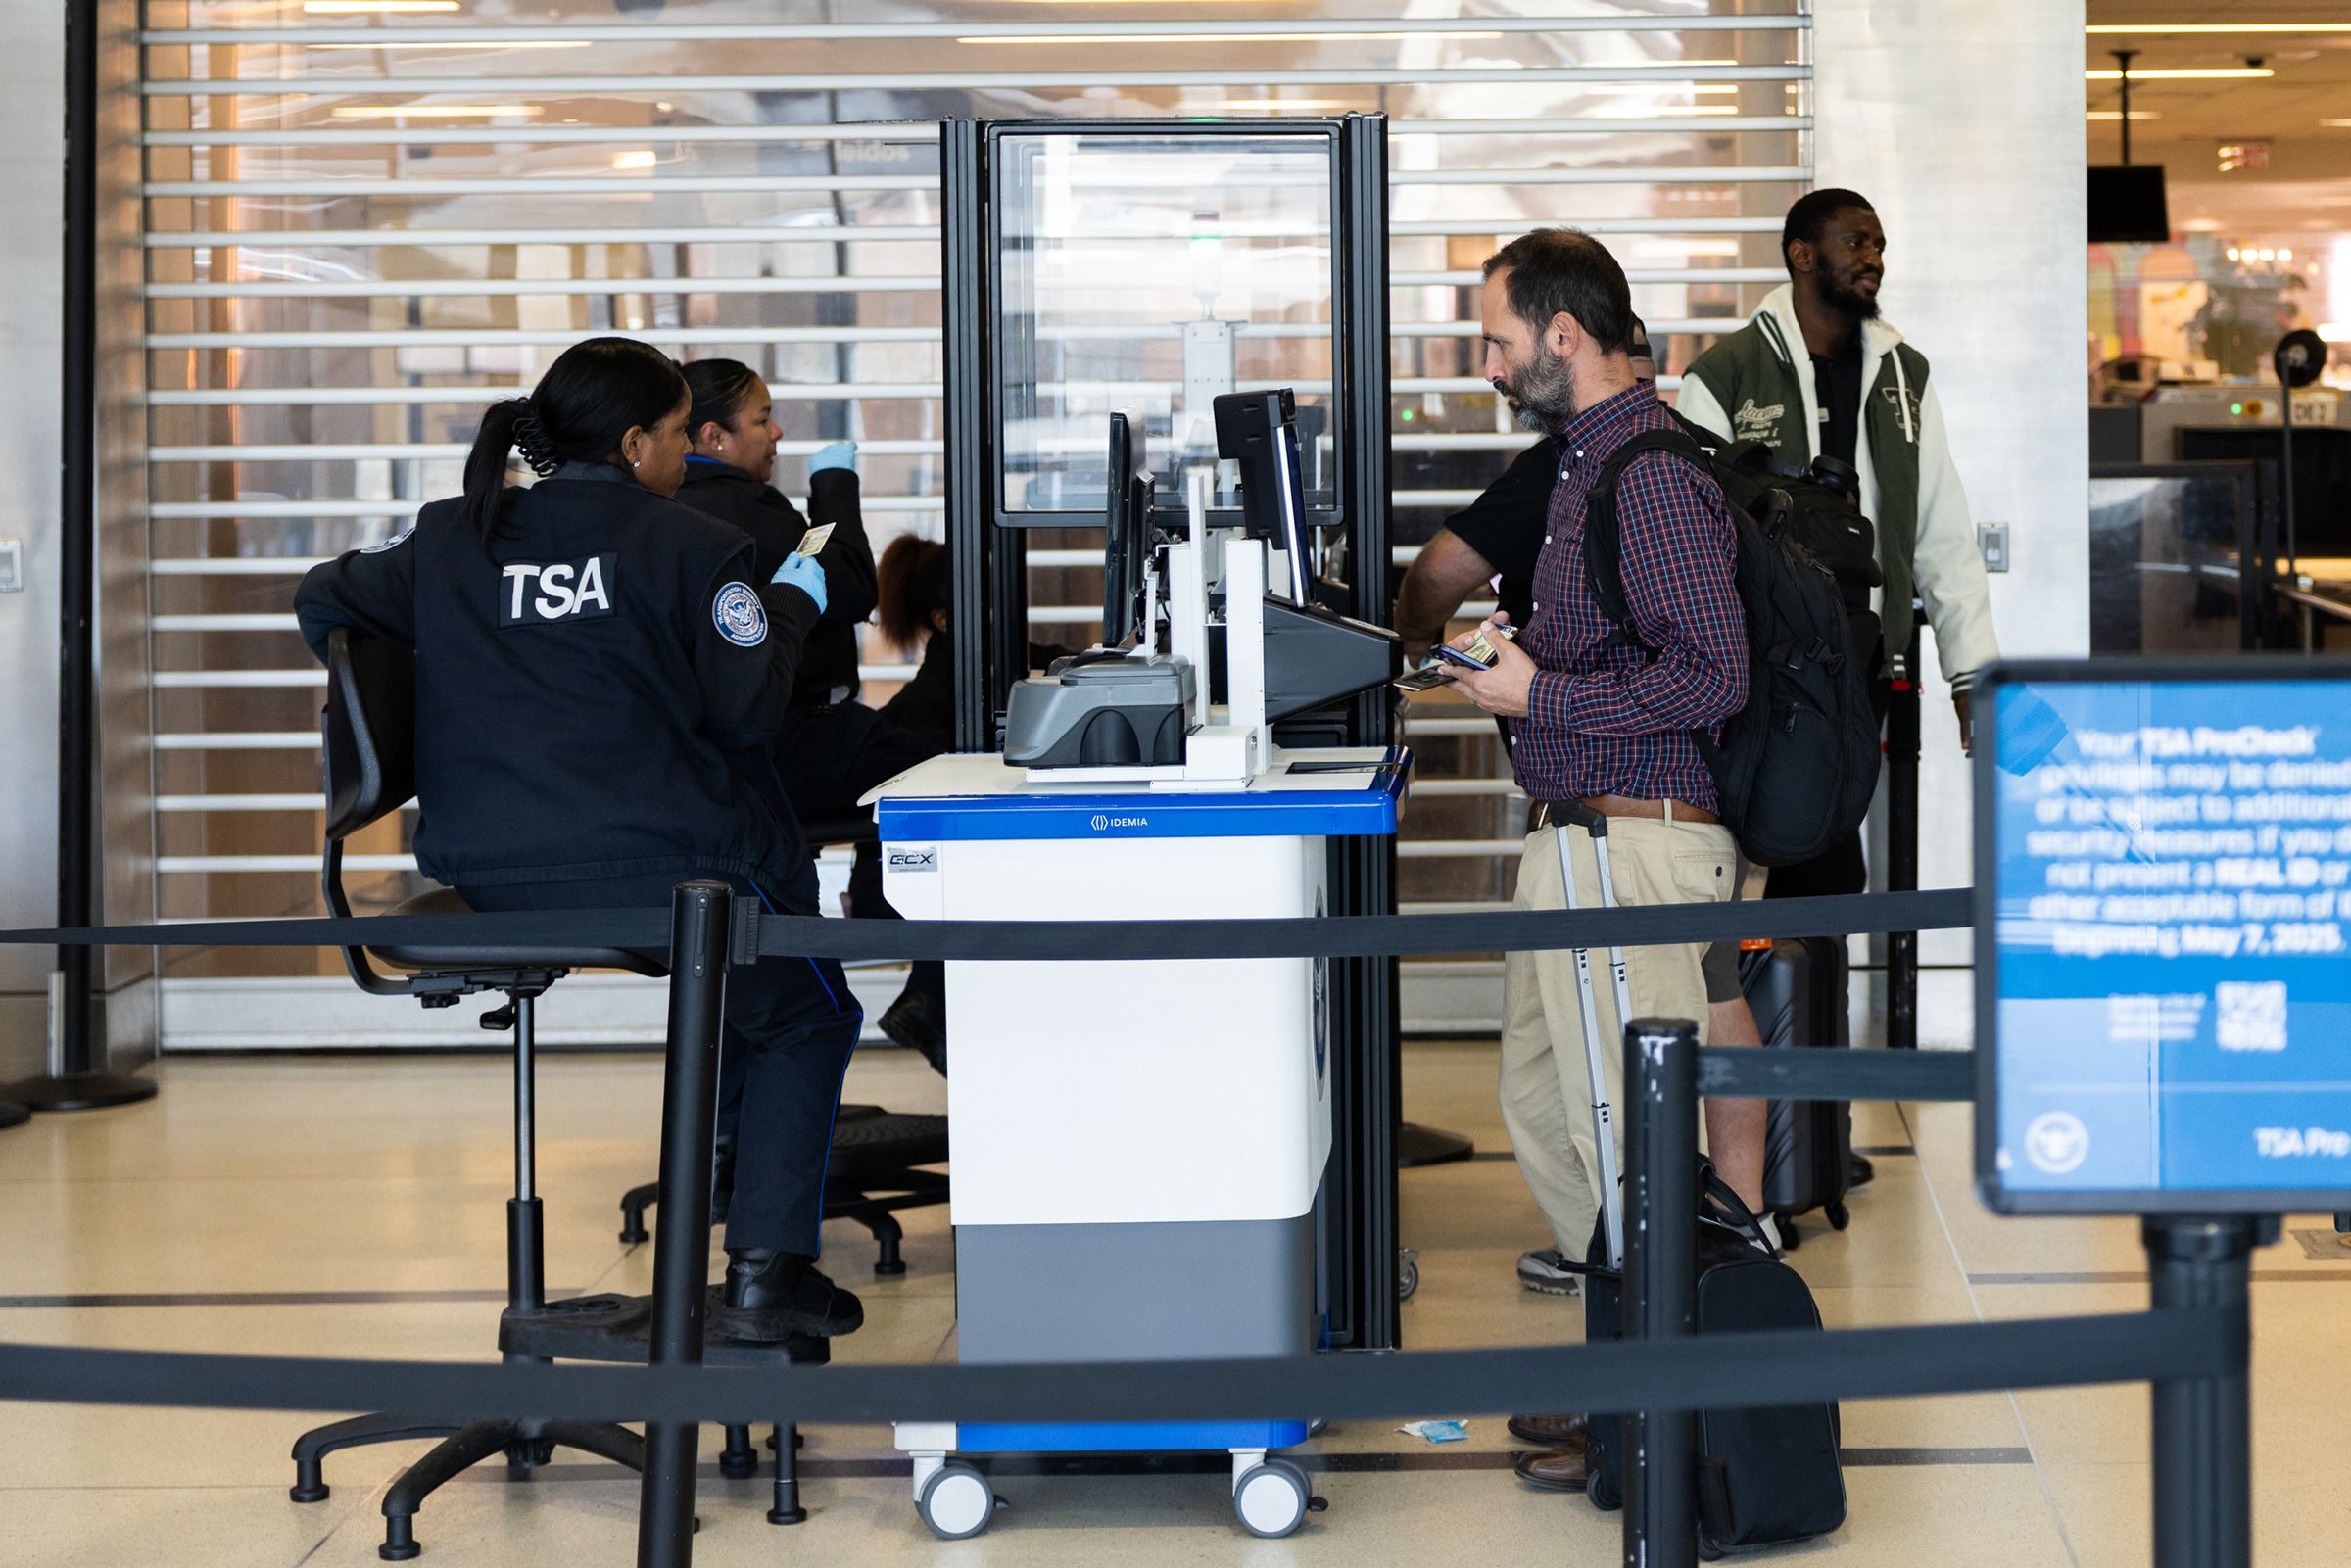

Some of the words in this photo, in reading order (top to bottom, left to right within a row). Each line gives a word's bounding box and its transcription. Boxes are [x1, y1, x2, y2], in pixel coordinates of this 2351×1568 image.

[503, 556, 610, 620] TSA
[2075, 729, 2135, 757] Your
[2139, 726, 2192, 757] TSA
[2167, 763, 2228, 793] may
[2229, 759, 2265, 788] be
[1110, 817, 1148, 827] IDEMIA
[2034, 797, 2067, 824] or
[2068, 796, 2104, 824] be
[2106, 795, 2198, 826] subject
[2200, 793, 2231, 822] to
[2026, 829, 2127, 858] security
[2130, 829, 2254, 856] measures
[2256, 825, 2279, 854] if
[2279, 827, 2333, 857] you
[889, 853, 934, 865] GCX
[2046, 862, 2090, 888] not
[2093, 861, 2191, 891] present
[2192, 862, 2214, 887] a
[2214, 857, 2285, 887] REAL
[2285, 856, 2319, 887] ID
[2319, 860, 2350, 886] or
[2029, 892, 2098, 921] other
[2101, 892, 2237, 922] acceptable
[2238, 889, 2304, 919] form
[2304, 888, 2335, 919] of
[2181, 924, 2241, 958] May
[2241, 922, 2271, 956] 7,
[2254, 1126, 2303, 1158] TSA
